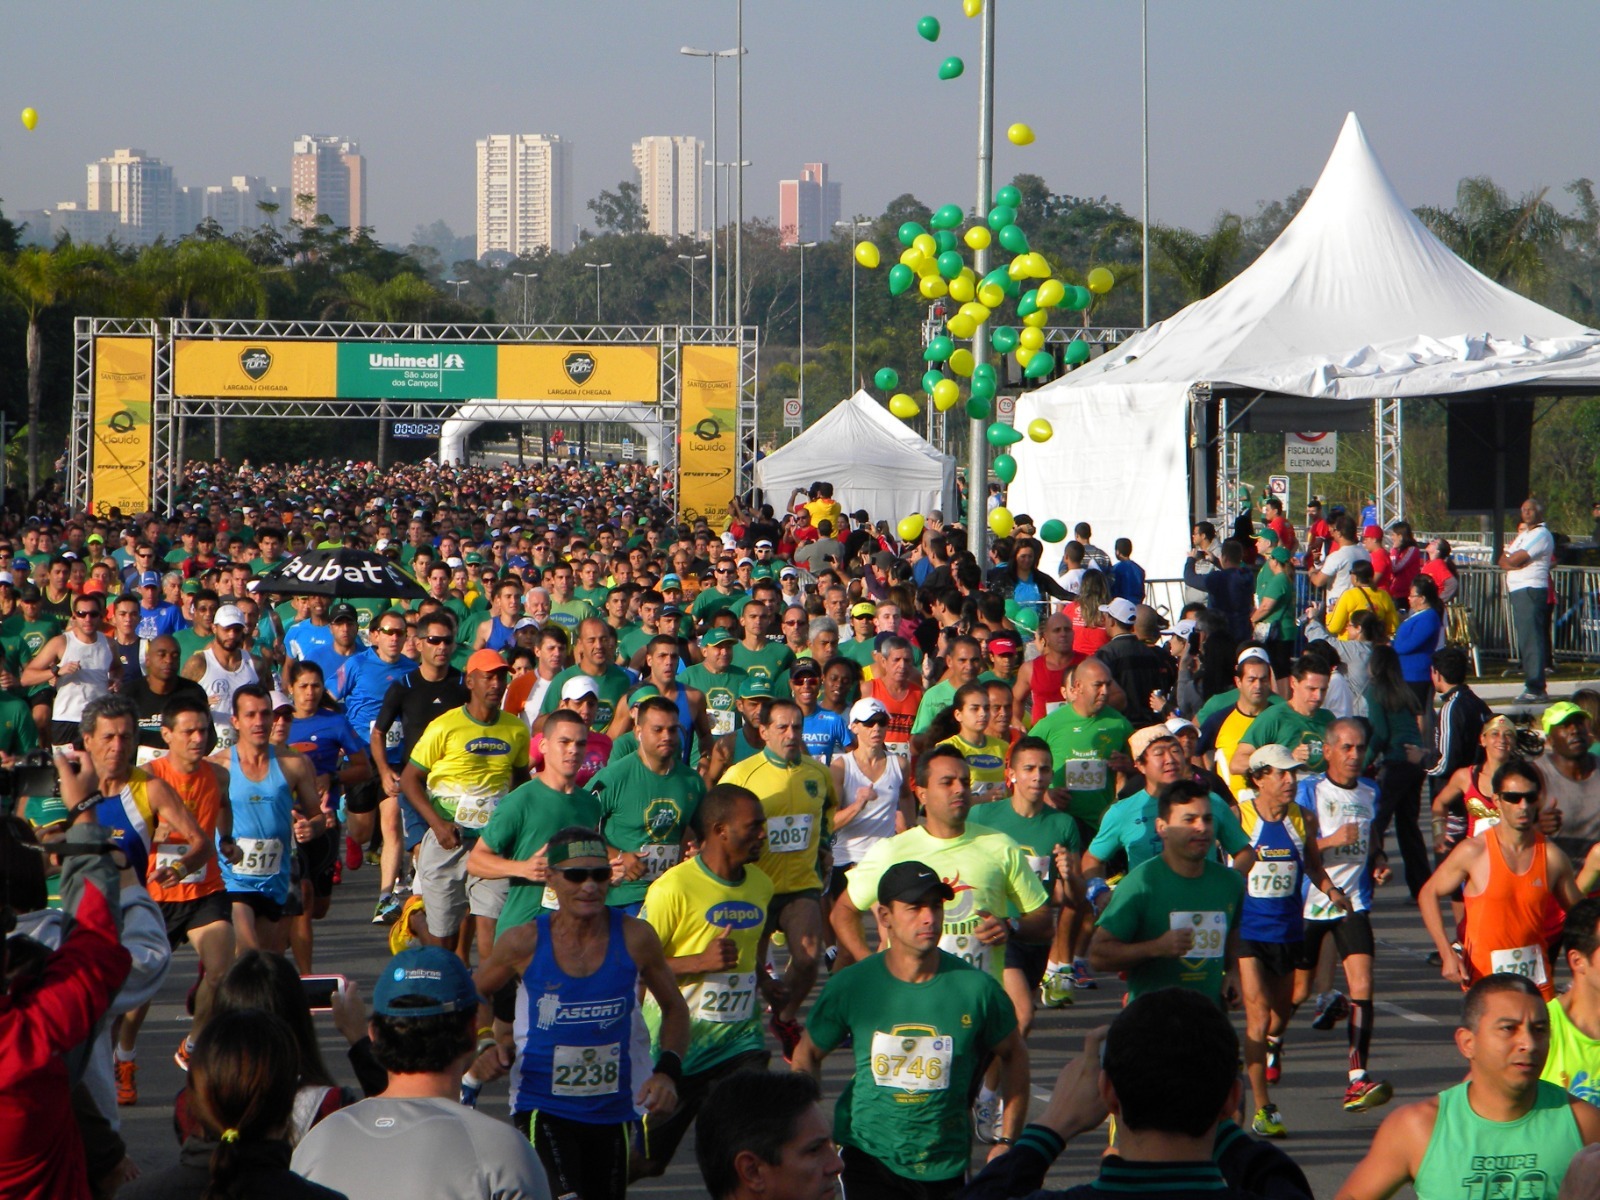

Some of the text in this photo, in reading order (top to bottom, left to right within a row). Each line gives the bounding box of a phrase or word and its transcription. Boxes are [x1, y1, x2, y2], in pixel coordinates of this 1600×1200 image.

[369, 353, 439, 368] Unimed
[404, 371, 438, 379] São José
[392, 379, 438, 388] dos Campos
[394, 423, 440, 434] 00:00:22
[1287, 446, 1334, 456] FISCALIZAÇÃO
[1290, 458, 1331, 467] ELETRÔNICA
[216, 738, 231, 748] 89
[387, 731, 400, 743] 83
[457, 807, 489, 823] 676
[770, 827, 809, 845] 2087
[1251, 875, 1292, 891] 1763
[713, 907, 759, 923] viapol
[944, 920, 979, 935] TUDIO
[1495, 959, 1538, 977] 1787
[701, 989, 752, 1012] 2277
[557, 1003, 622, 1019] ASCORT
[554, 1061, 618, 1086] 2238
[874, 1053, 942, 1080] 6746
[1471, 1153, 1538, 1172] EQUIPE
